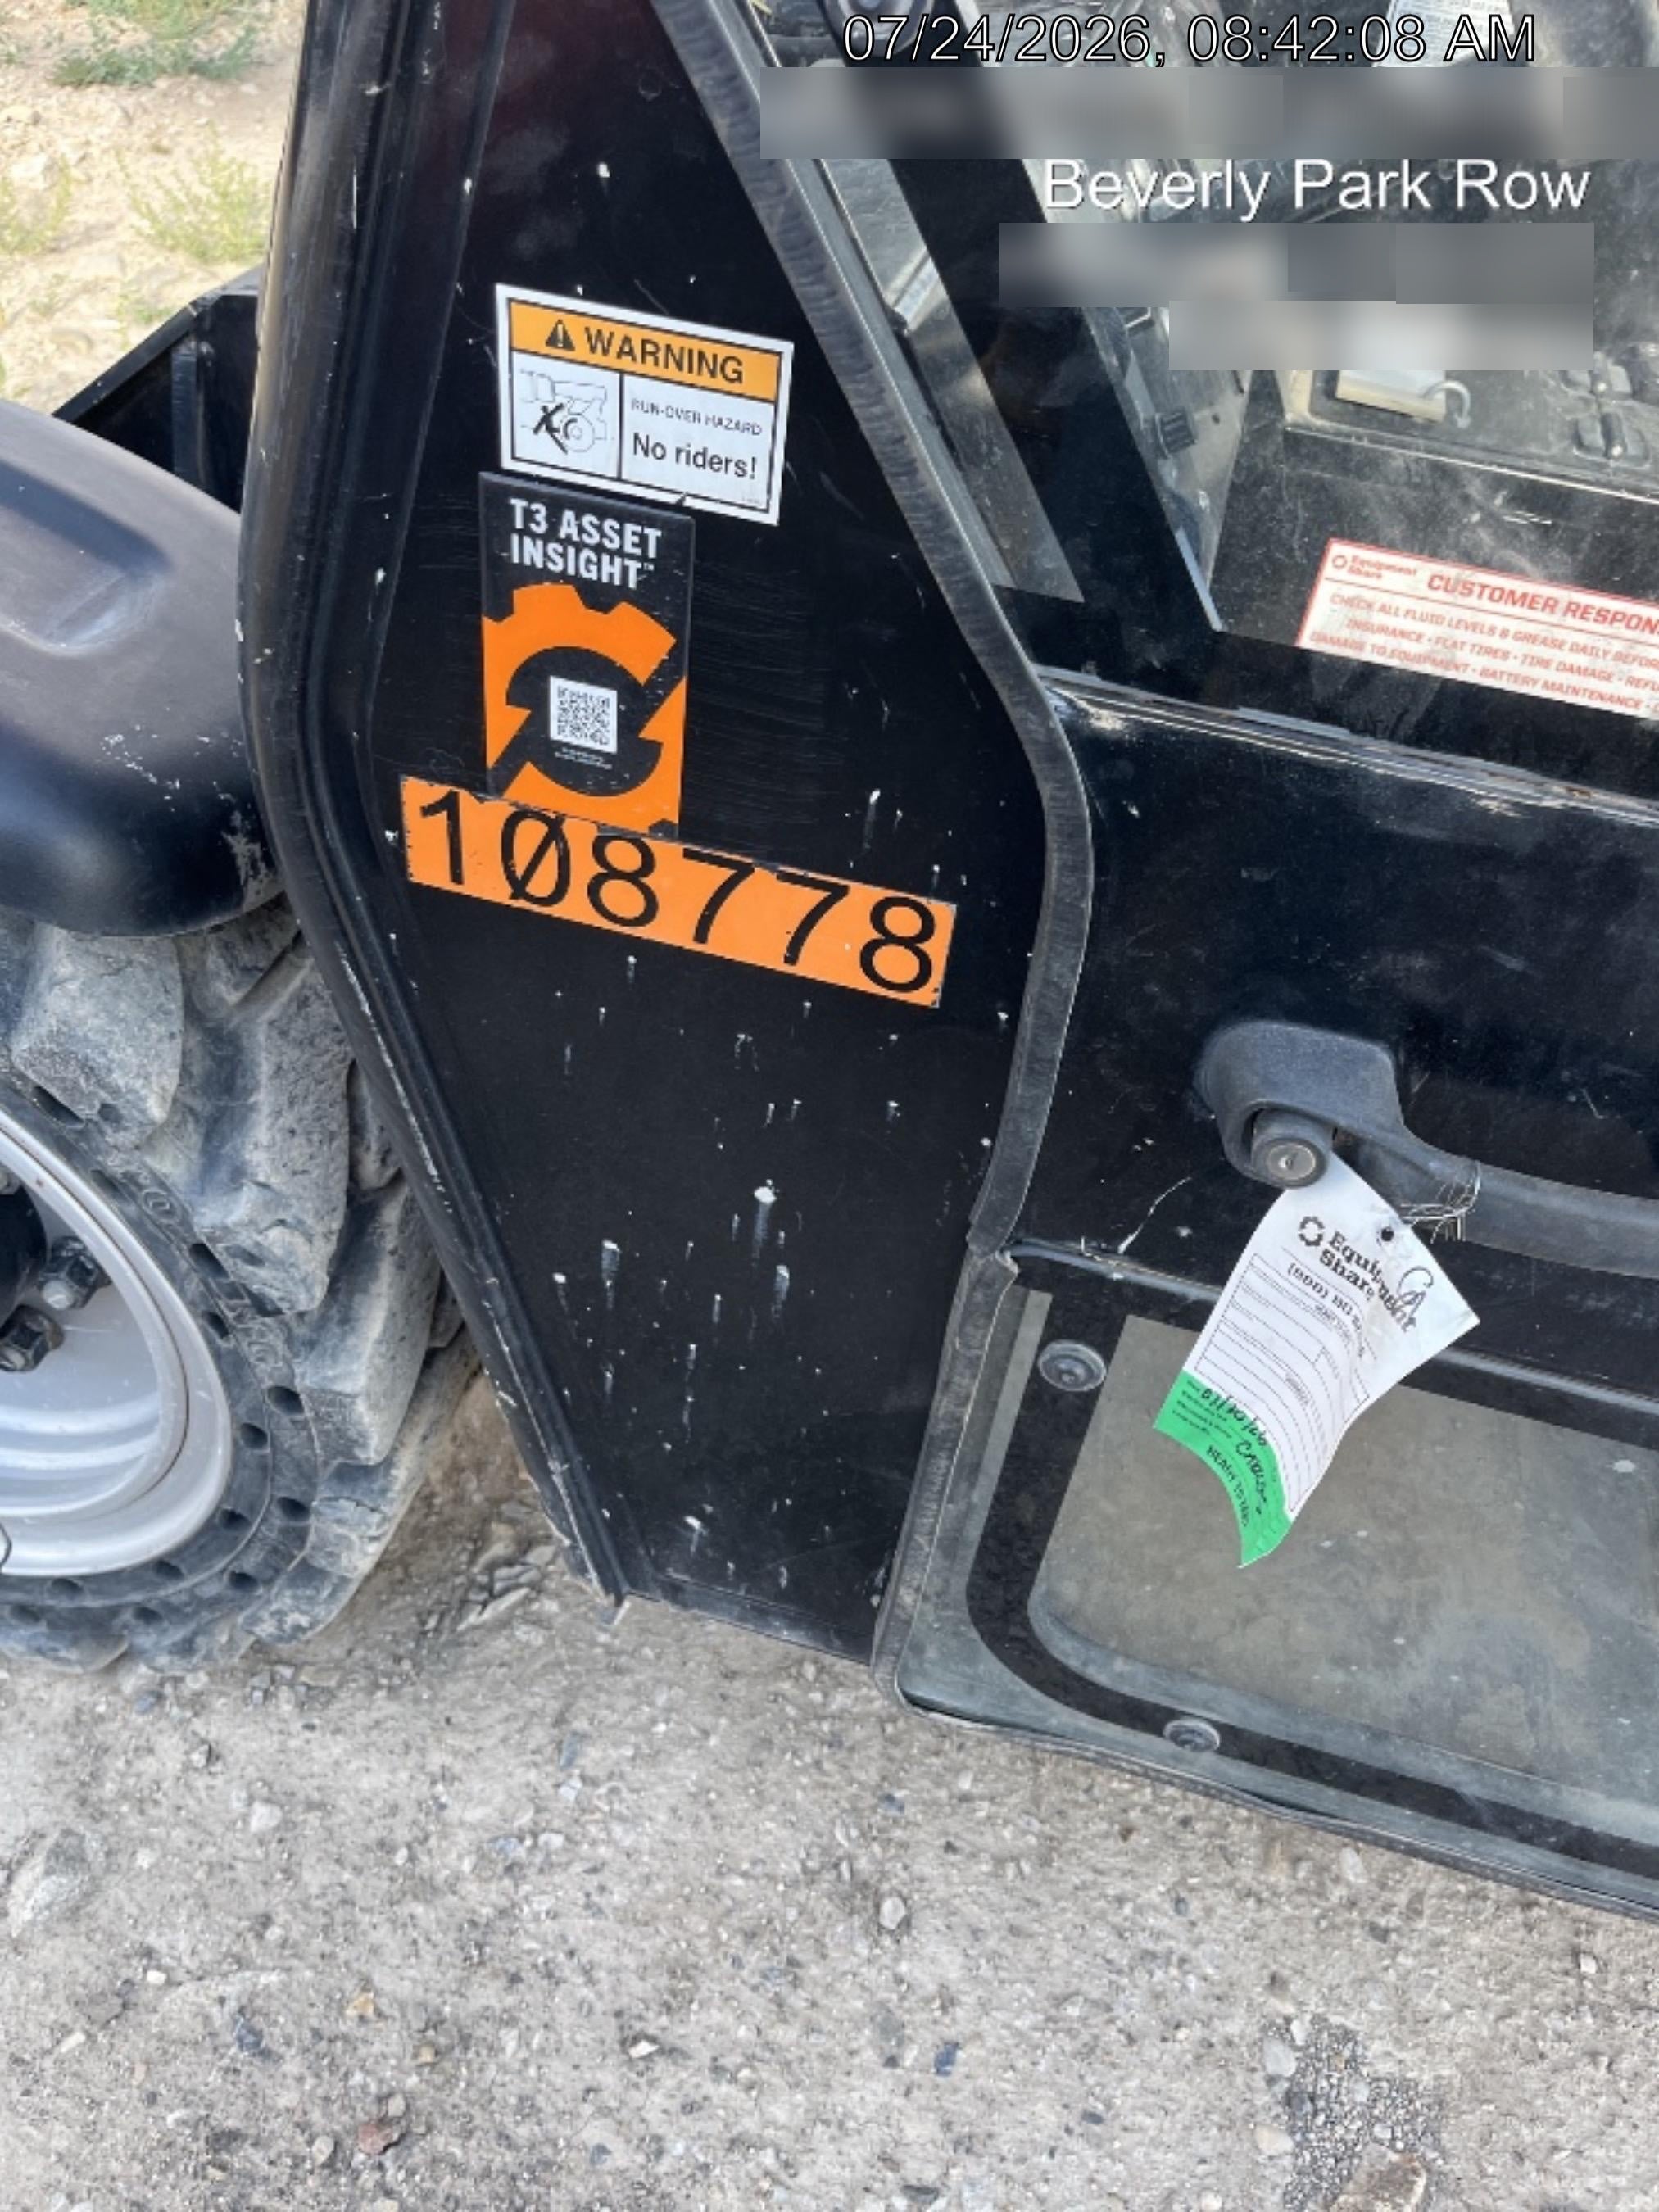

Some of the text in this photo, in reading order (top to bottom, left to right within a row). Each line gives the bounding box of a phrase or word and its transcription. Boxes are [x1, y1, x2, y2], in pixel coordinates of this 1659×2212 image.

[584, 326, 744, 384] WARNING
[705, 414, 763, 436] HAZARD
[632, 432, 757, 480] No riders!
[510, 497, 662, 559] T3 ASSET
[1379, 602, 1402, 617] ALL
[1427, 573, 1659, 636] CUSTOMER RESPON
